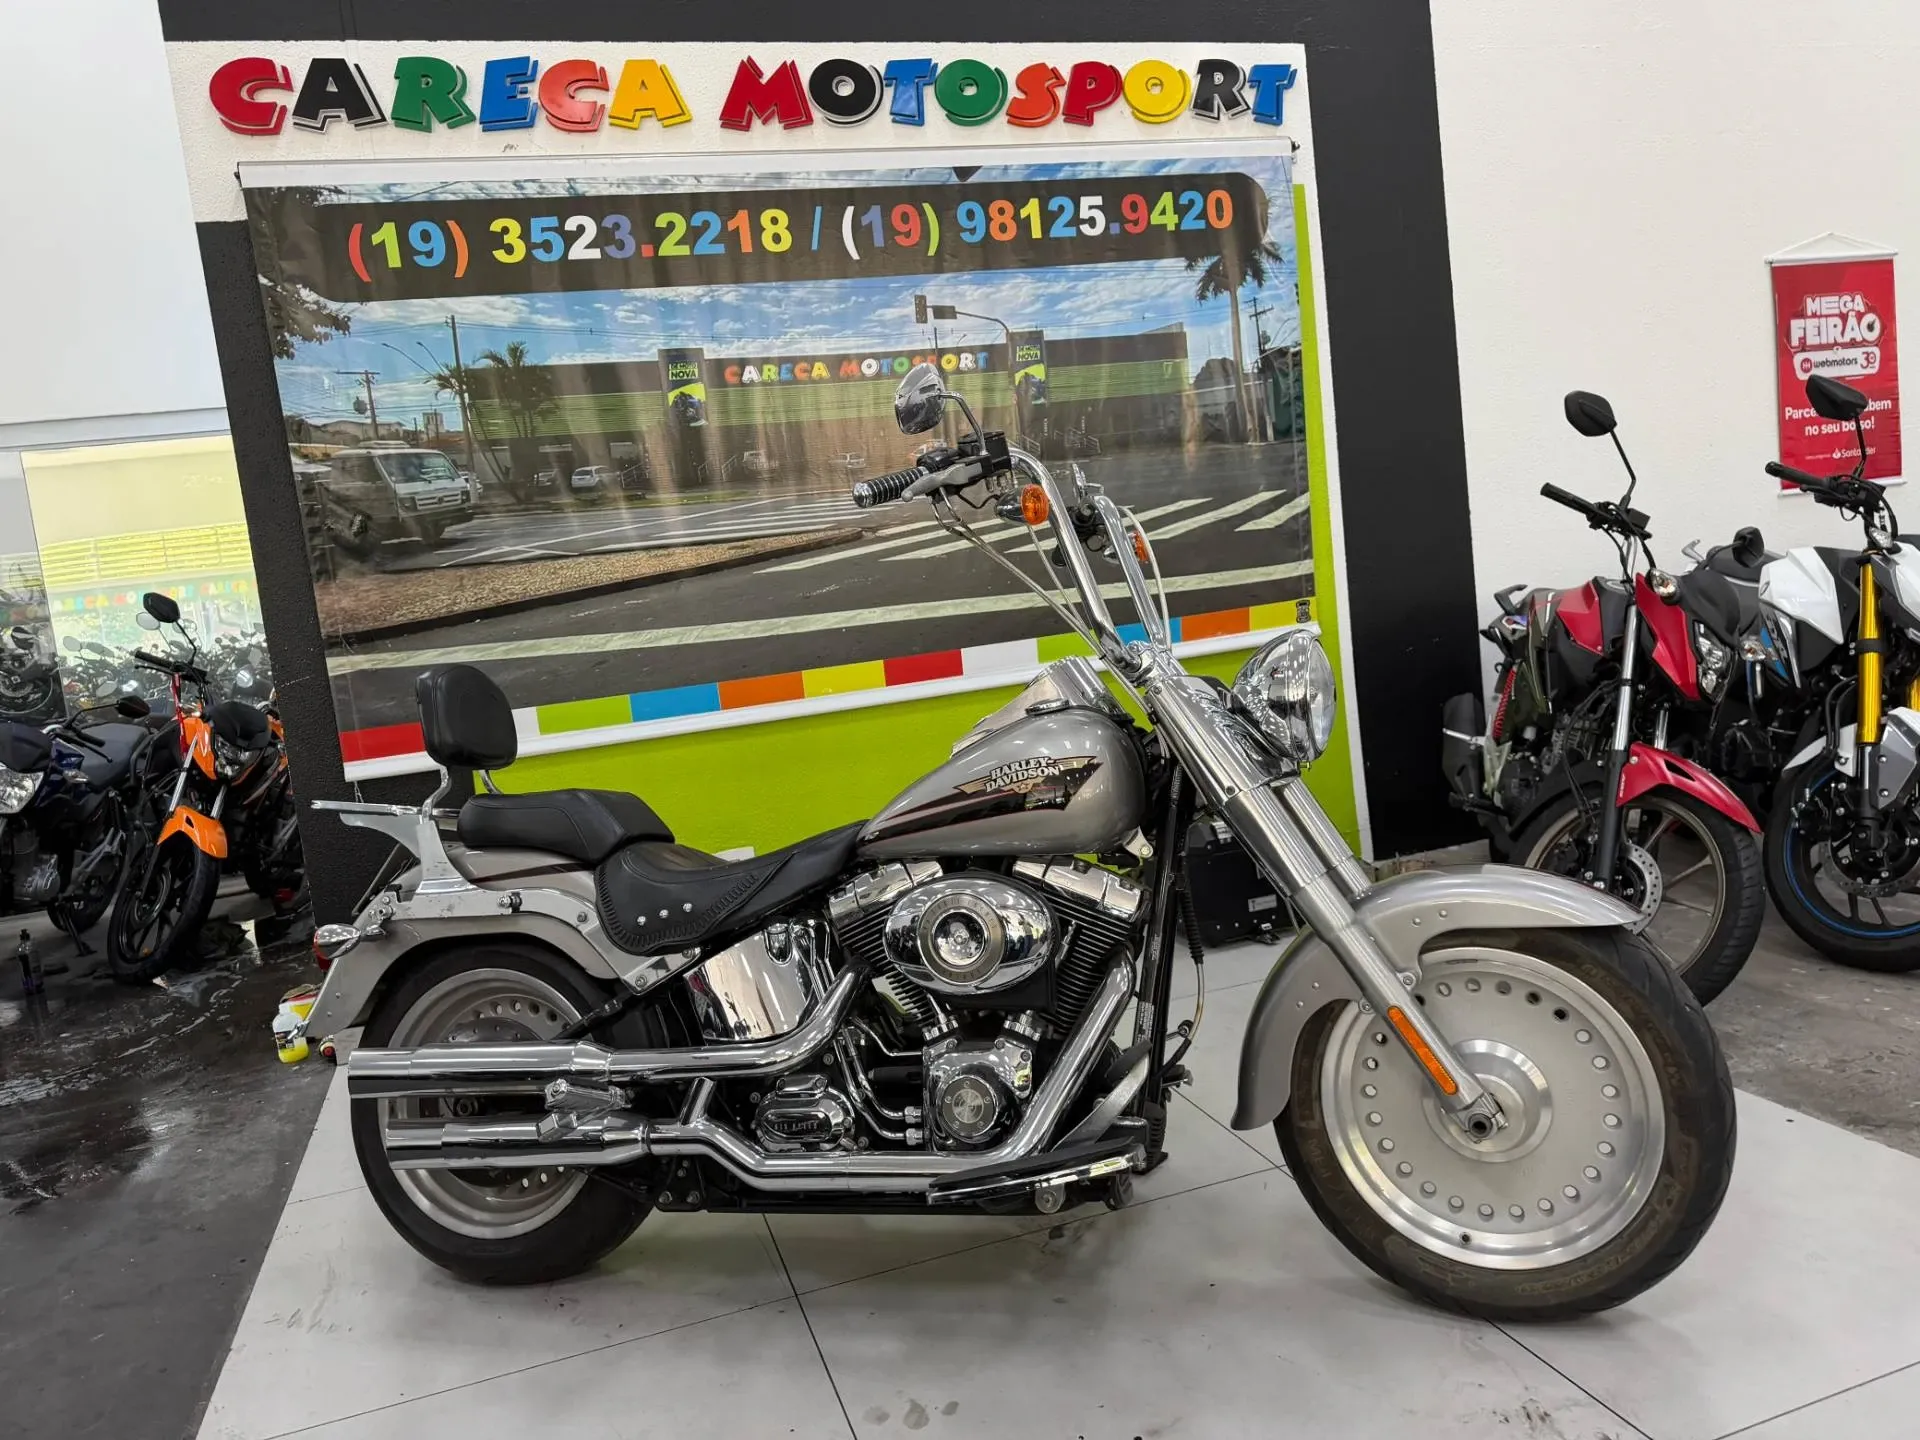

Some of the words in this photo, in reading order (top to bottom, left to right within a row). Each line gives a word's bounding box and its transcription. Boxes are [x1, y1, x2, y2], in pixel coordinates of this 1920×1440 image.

[208, 55, 693, 136] CARECA
[719, 55, 1297, 129] MOTOSPORT
[348, 220, 469, 283] (19)
[489, 208, 793, 264] 3523.2218
[811, 205, 823, 251] /
[841, 202, 940, 261] (19)
[956, 189, 1234, 244] 98125.9420
[1806, 294, 1865, 316] MEGA
[1790, 311, 1881, 347] FEIRÃO
[724, 359, 831, 384] CARECA
[1814, 356, 1858, 369] webmotors
[671, 370, 696, 378] NOVA
[1785, 406, 1819, 420] Parce
[1805, 424, 1819, 436] no
[1821, 422, 1840, 433] seu
[1842, 416, 1875, 430] boso!
[1841, 446, 1876, 458] Santader
[985, 765, 1060, 792] DAVIDSON
